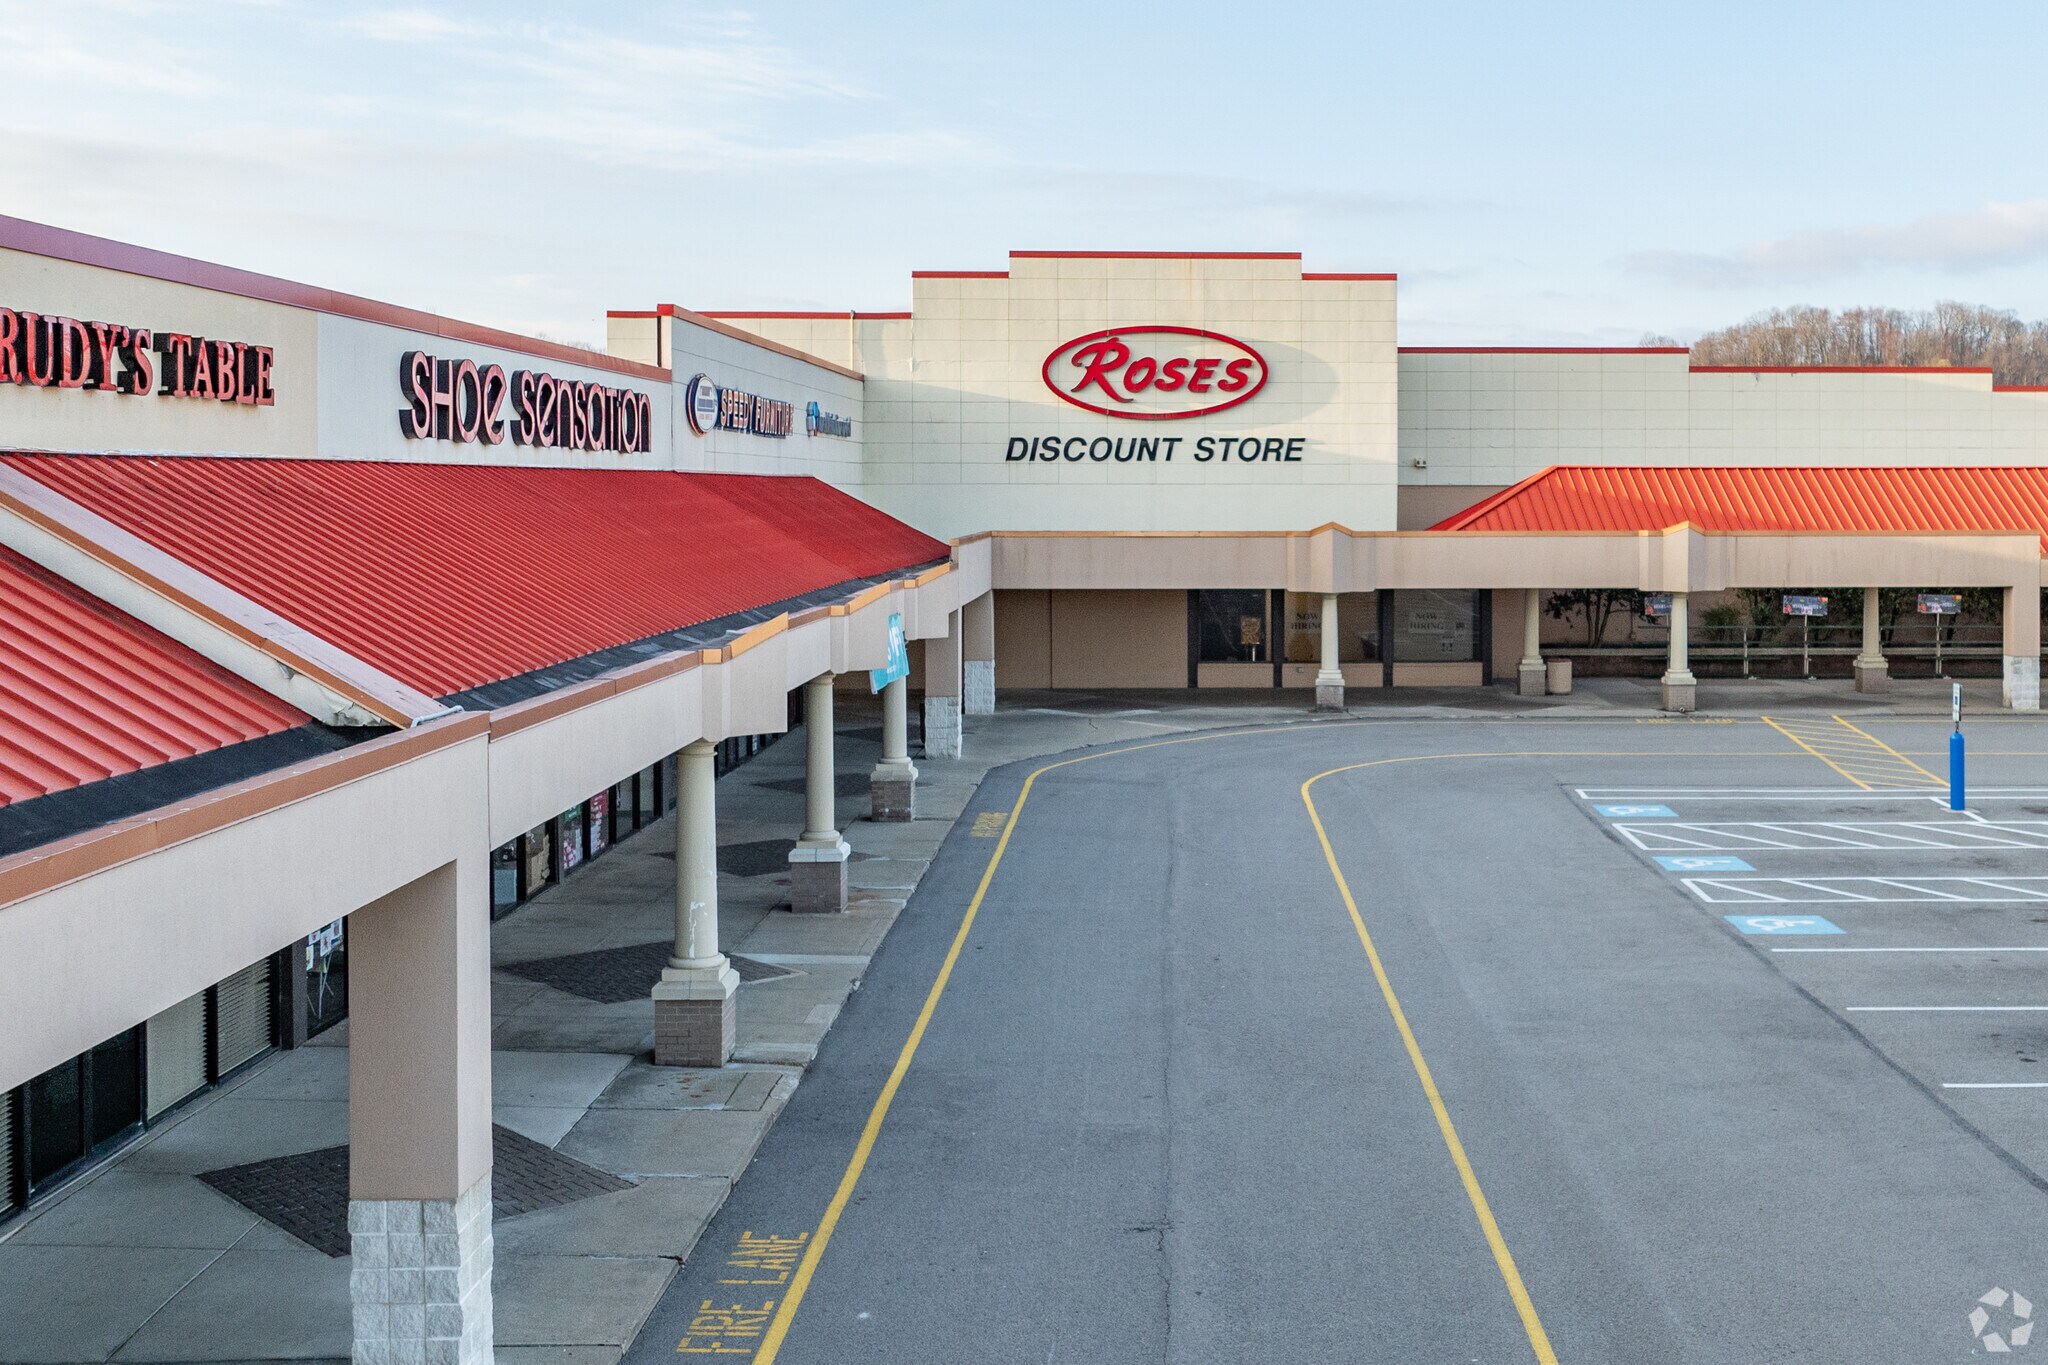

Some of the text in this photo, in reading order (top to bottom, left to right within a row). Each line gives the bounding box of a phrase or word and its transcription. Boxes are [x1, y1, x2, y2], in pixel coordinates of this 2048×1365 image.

[154, 333, 274, 406] TABLE
[1071, 337, 1254, 403] ROSES
[720, 388, 754, 430] SPEEDY
[755, 396, 794, 436] FURNITURE
[1005, 436, 1306, 463] DISCOUNT STORE
[1296, 612, 1319, 621] NOW
[676, 1231, 809, 1353] FIRE LANE
